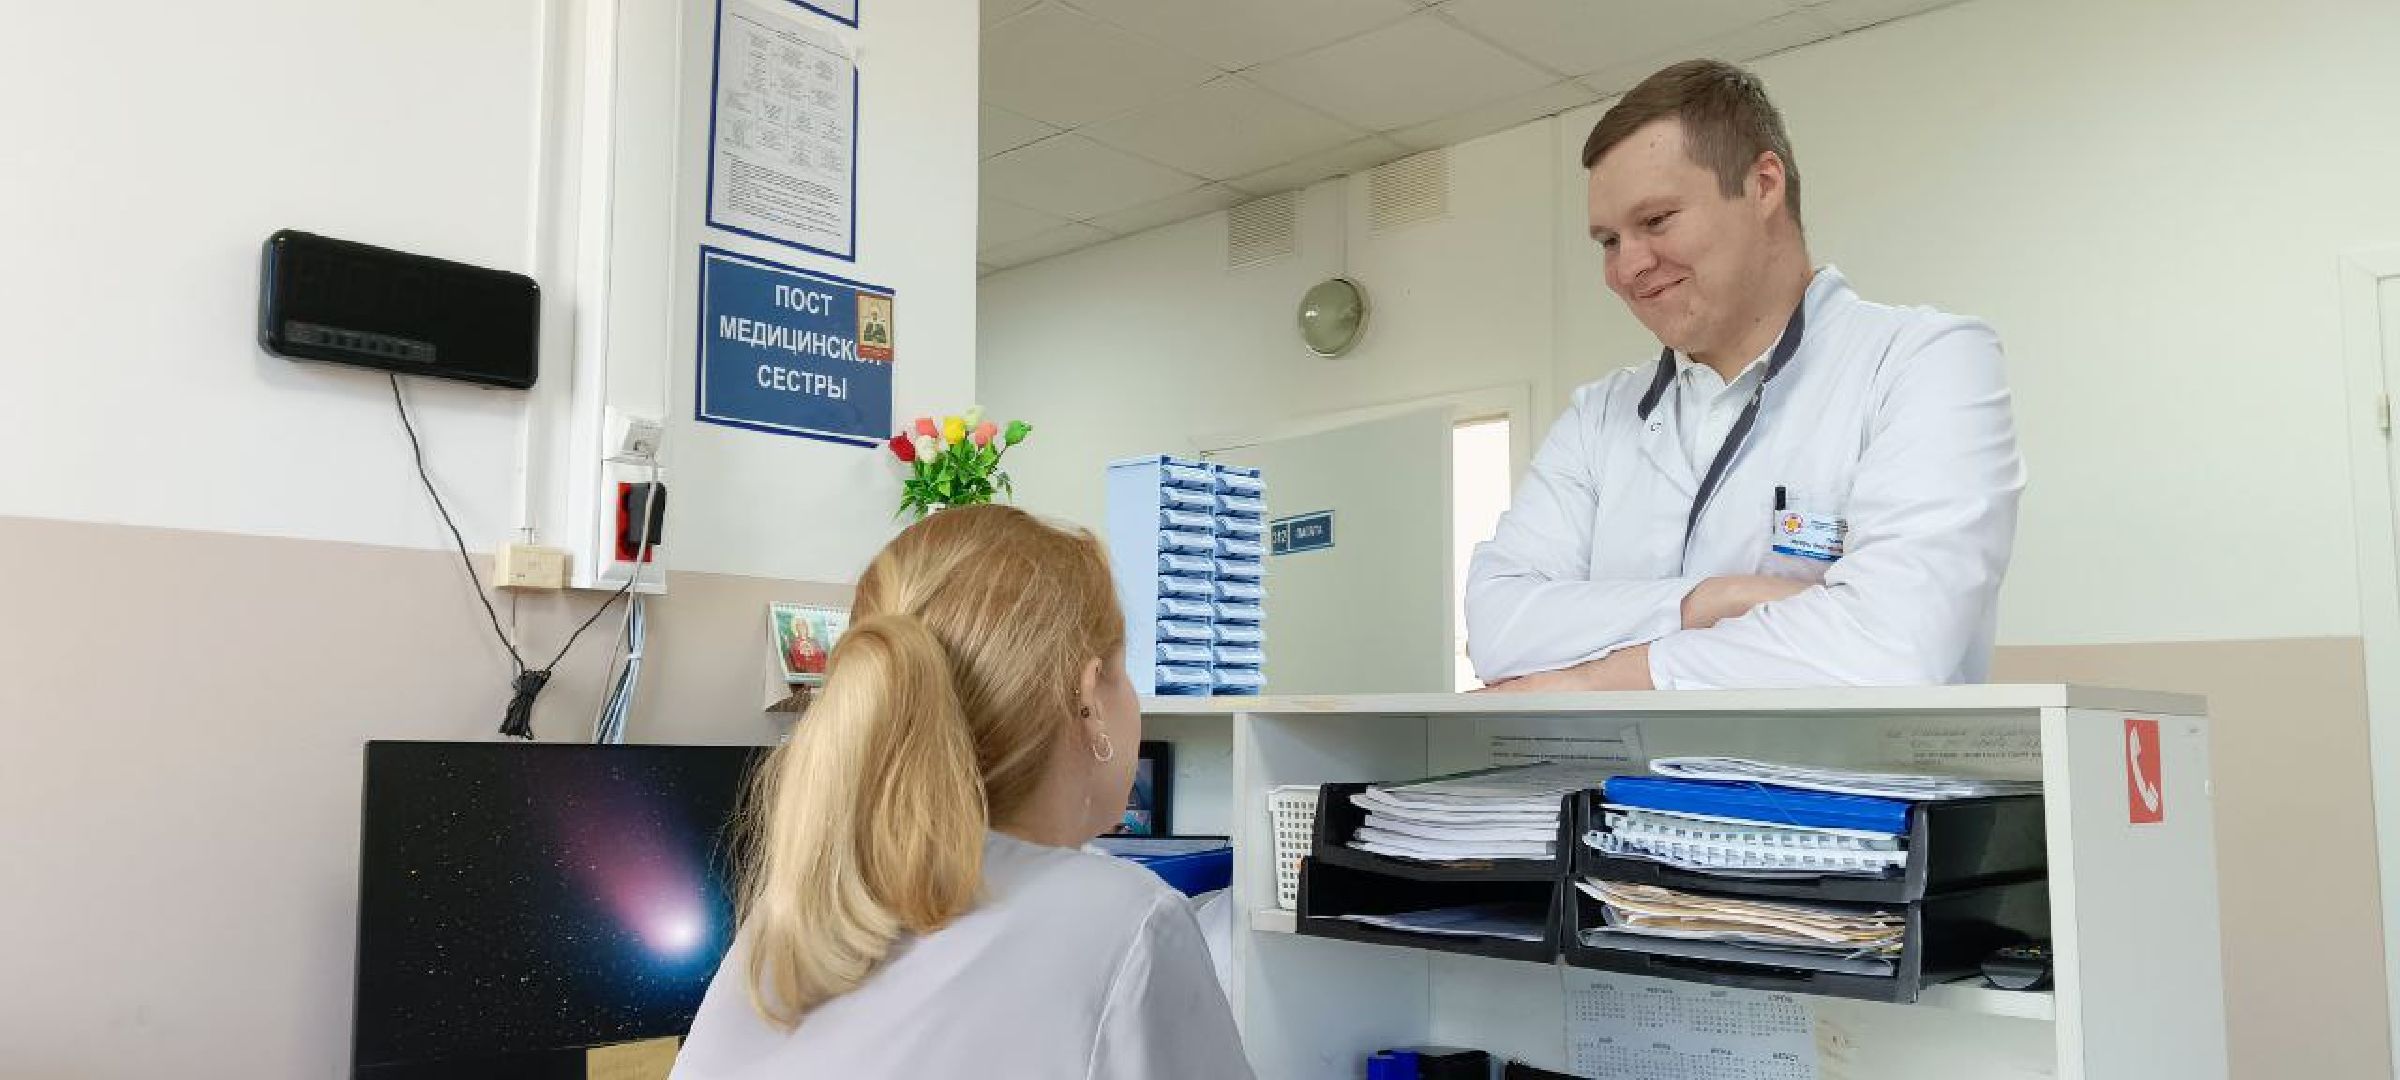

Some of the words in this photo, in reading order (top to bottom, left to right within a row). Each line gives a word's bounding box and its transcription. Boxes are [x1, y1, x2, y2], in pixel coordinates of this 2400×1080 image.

[775, 284, 833, 316] ПОСТ
[719, 314, 881, 366] МЕДИЦИНСК
[757, 364, 847, 400] СЕСТРЫ
